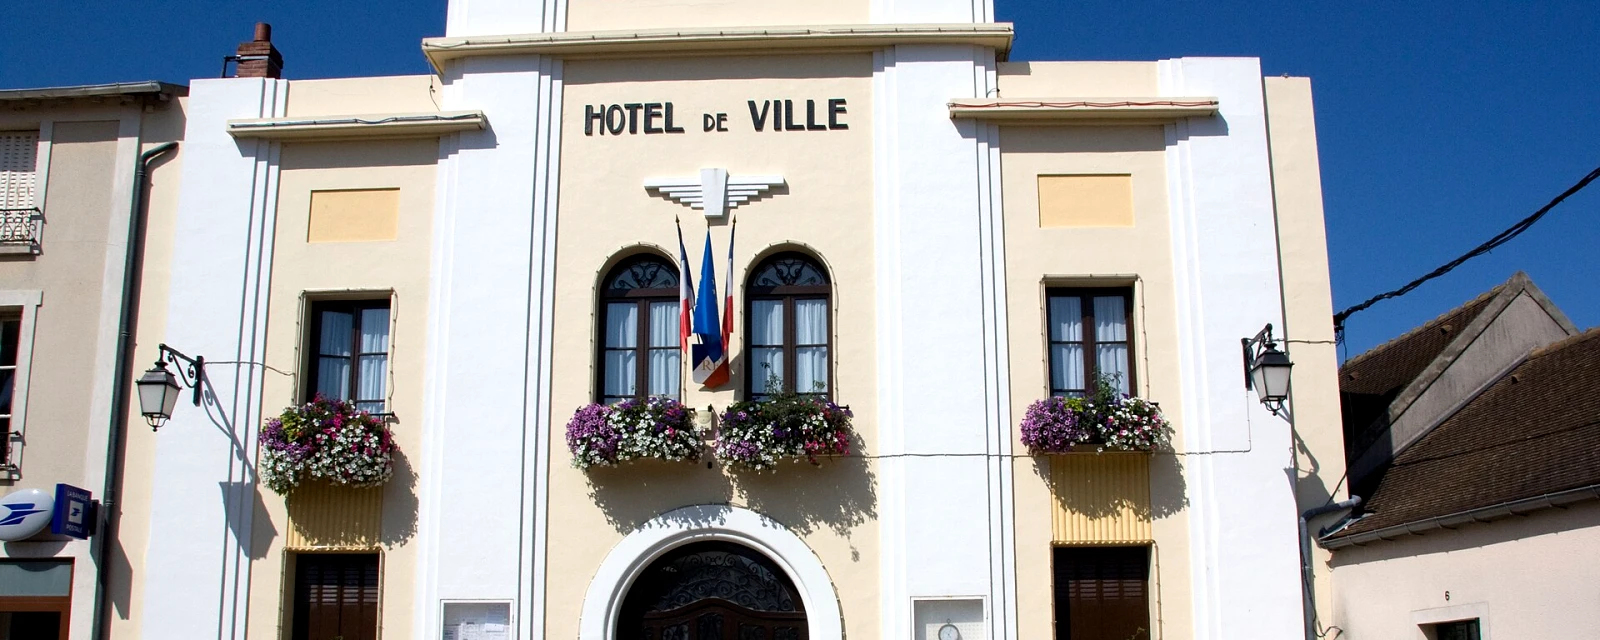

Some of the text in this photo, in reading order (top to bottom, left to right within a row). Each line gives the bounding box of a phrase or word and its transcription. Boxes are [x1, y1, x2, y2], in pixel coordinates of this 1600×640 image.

[585, 98, 849, 136] HOTEL DE VILLE
[1445, 590, 1450, 601] 6
